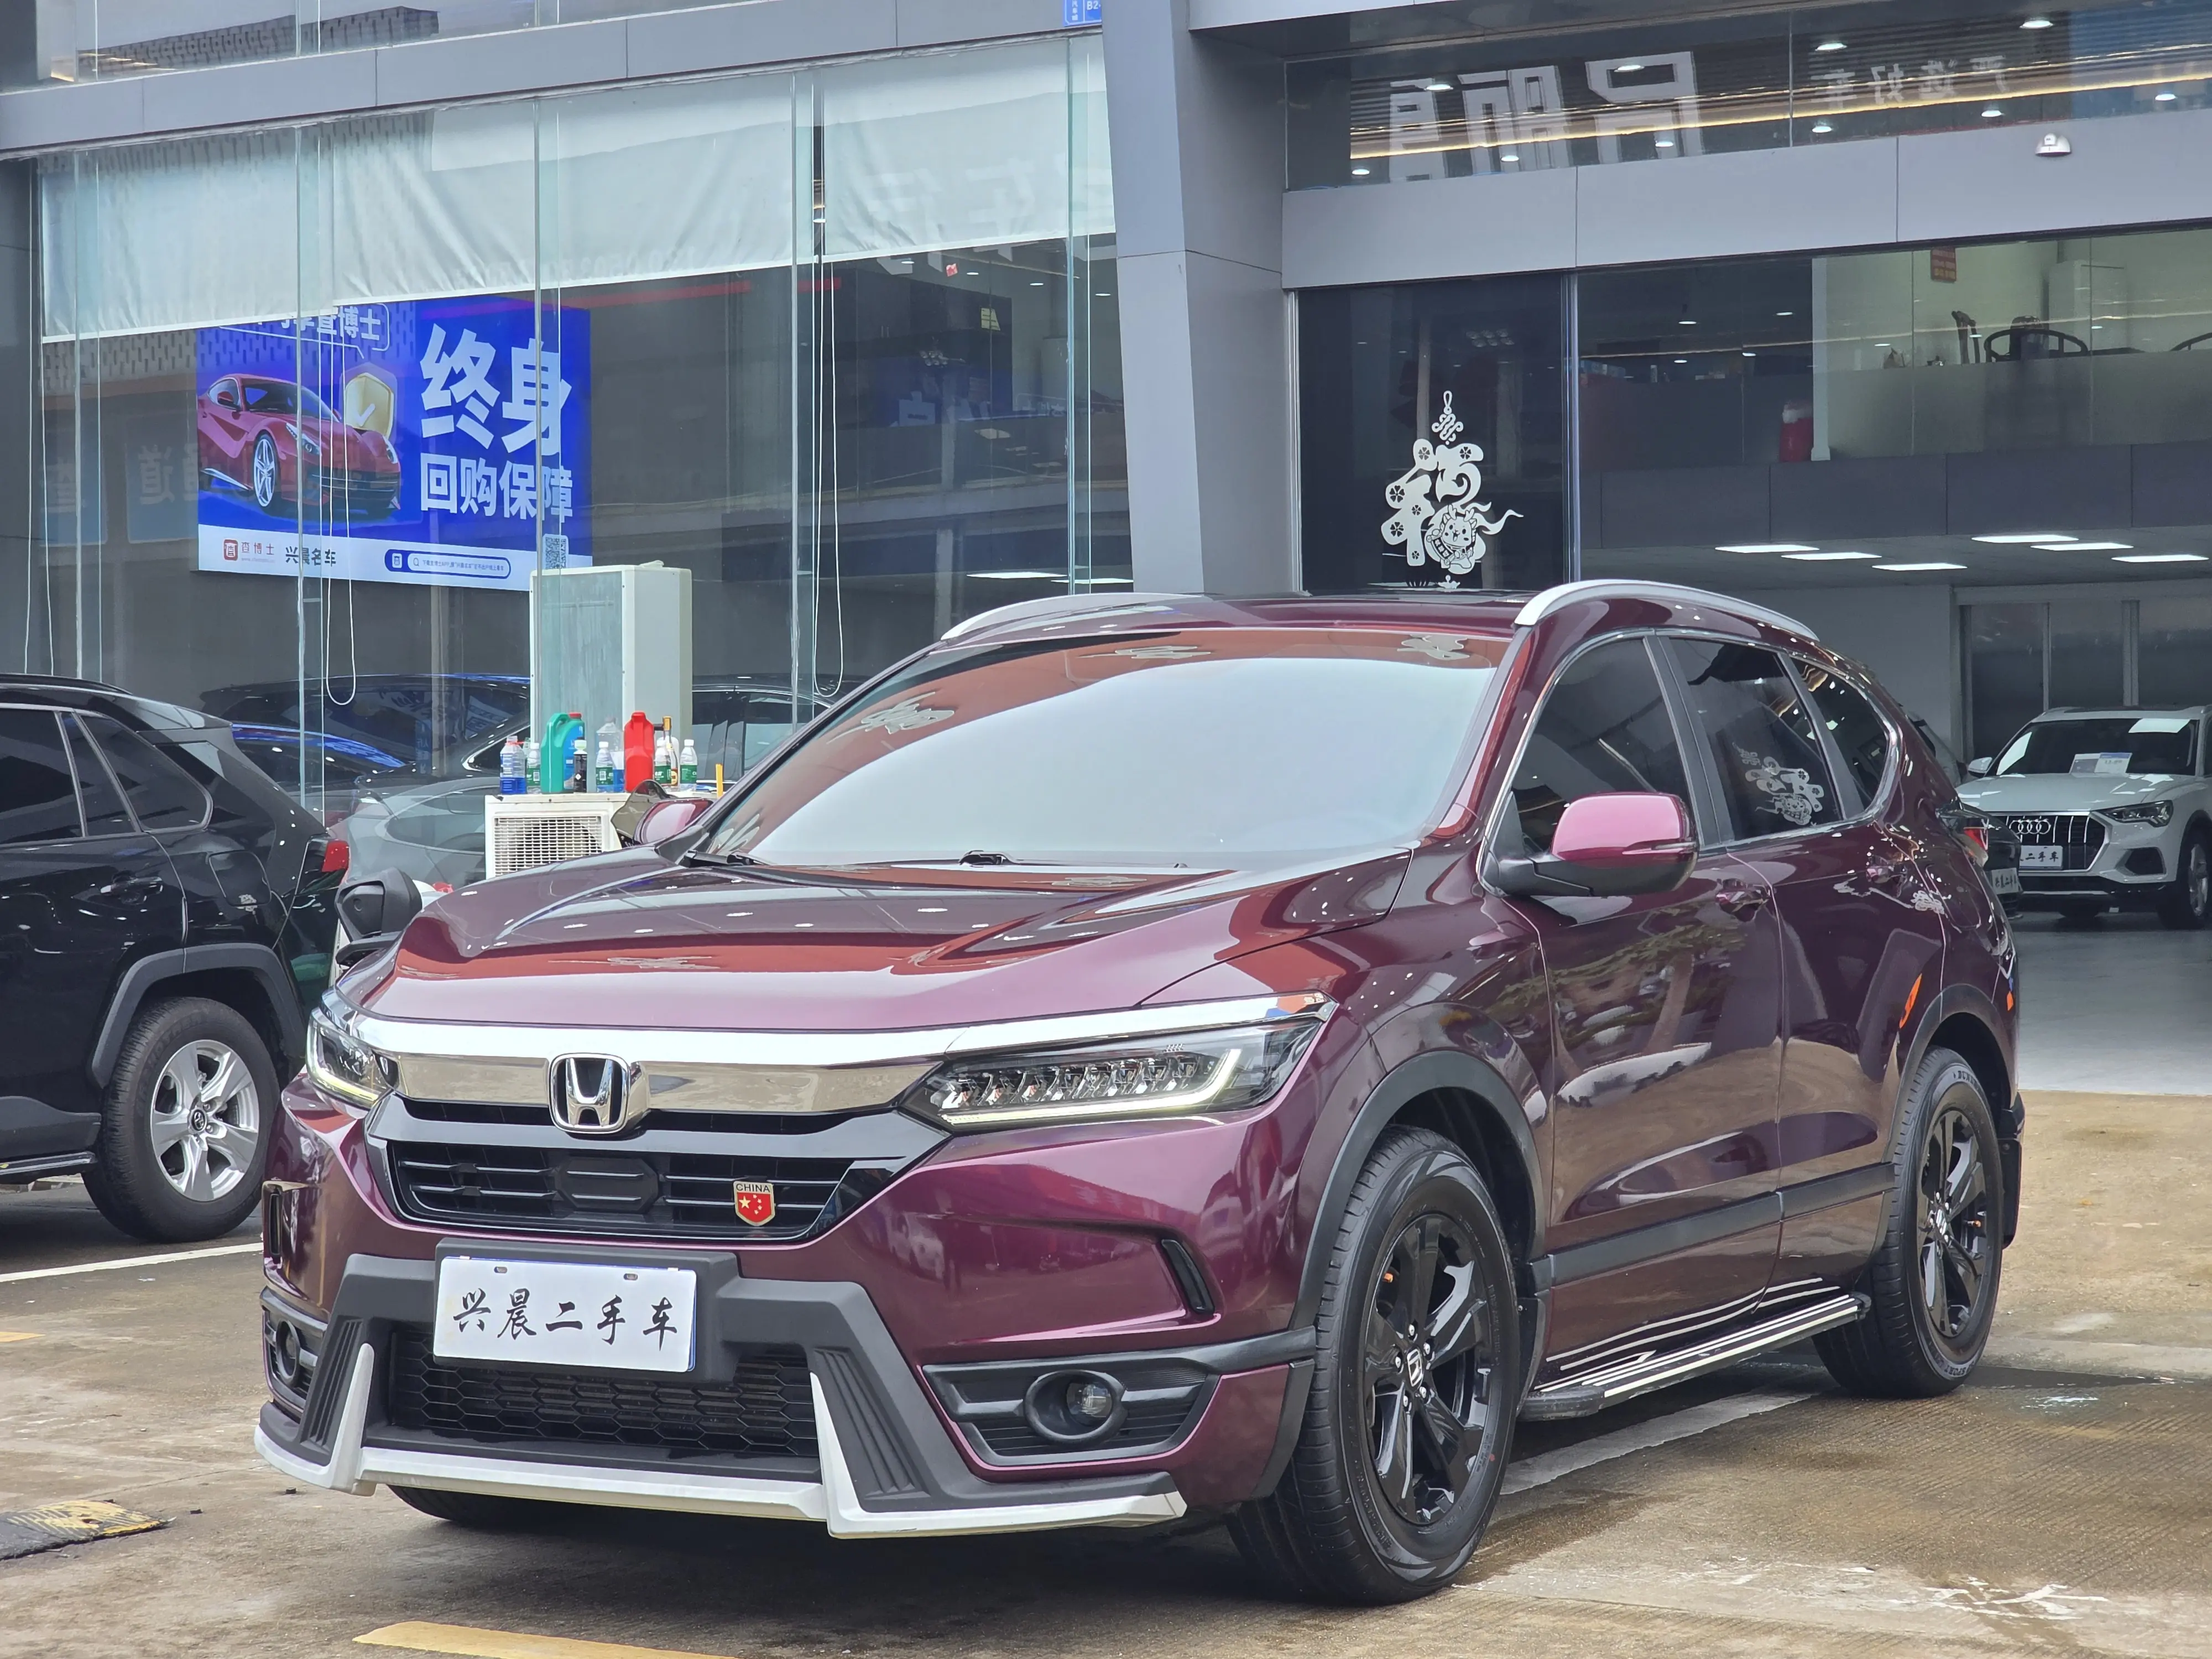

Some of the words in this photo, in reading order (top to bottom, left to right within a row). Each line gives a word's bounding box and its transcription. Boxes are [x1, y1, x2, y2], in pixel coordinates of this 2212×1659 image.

[420, 323, 572, 456] 终身
[420, 452, 573, 523] 回购保障
[241, 541, 274, 555] 查博士
[285, 546, 336, 567] 兴晨名车
[2020, 851, 2058, 863] 二手车
[736, 1183, 771, 1193] CHINA
[453, 1287, 677, 1351] 兴晨二手车
